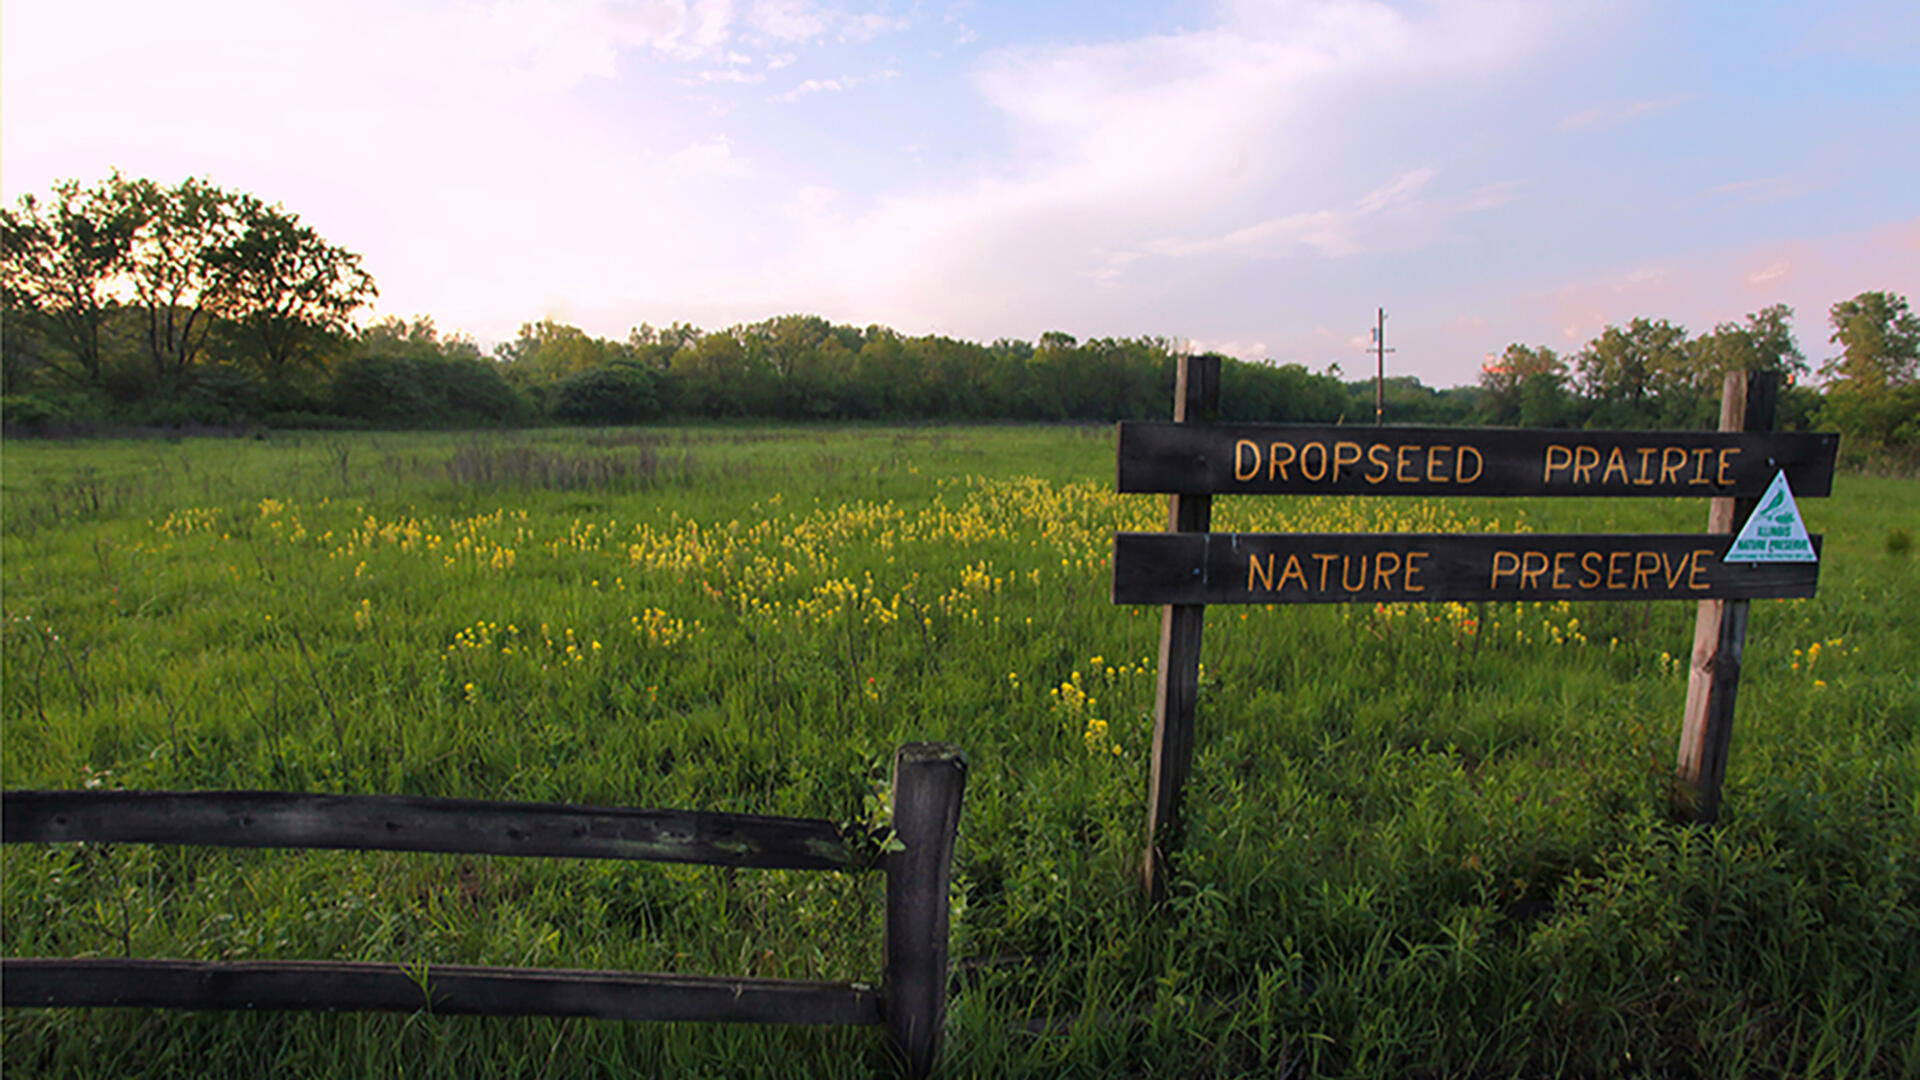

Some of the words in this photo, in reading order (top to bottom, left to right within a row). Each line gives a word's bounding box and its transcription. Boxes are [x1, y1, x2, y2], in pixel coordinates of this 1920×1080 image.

[1235, 439, 1483, 484] DROPSEED
[1544, 446, 1741, 485] PRAIRIE
[1247, 551, 1430, 592] NATURE
[1491, 549, 1714, 591] PRESERVE
